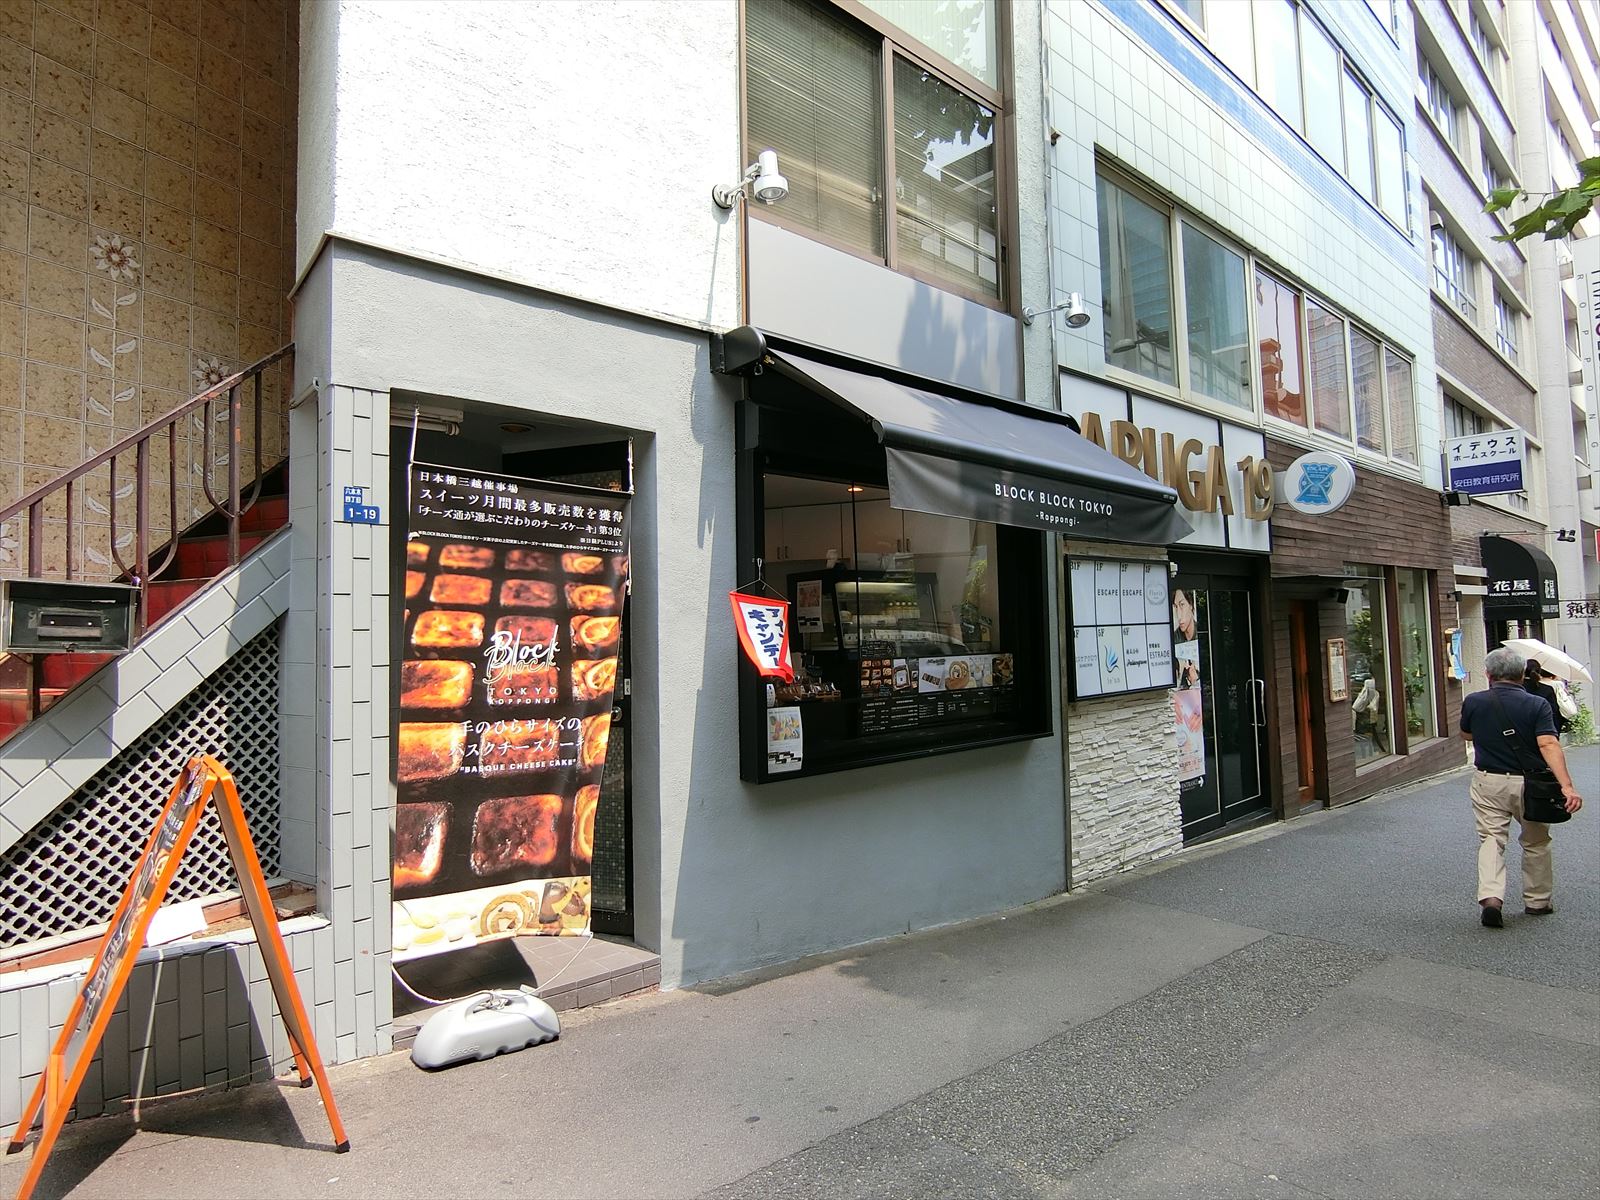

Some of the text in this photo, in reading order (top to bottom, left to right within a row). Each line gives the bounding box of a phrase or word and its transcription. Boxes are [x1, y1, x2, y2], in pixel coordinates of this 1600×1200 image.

[1453, 436, 1516, 453] イデウス
[1454, 448, 1516, 461] ホームスクール
[420, 471, 518, 494] 日本橋三越催事場
[1237, 455, 1275, 521] 19
[1454, 473, 1519, 488] 安田教育研究所
[420, 488, 623, 523] スイーツ月間最多販売数を獲得
[995, 484, 1114, 516] BLOCK BLOCK TOKYO
[349, 508, 376, 519] 1-19
[1035, 511, 1080, 527] -Roppongi-
[1493, 580, 1531, 591] 花屋
[765, 608, 784, 638] アイ
[490, 624, 561, 668] Block
[489, 687, 557, 696] TOKYO
[489, 697, 556, 705] ROPPONGI
[460, 716, 582, 736] 手のひらサイズの
[449, 738, 584, 758] バスクチーズケーキ
[509, 762, 546, 771] CHEESE
